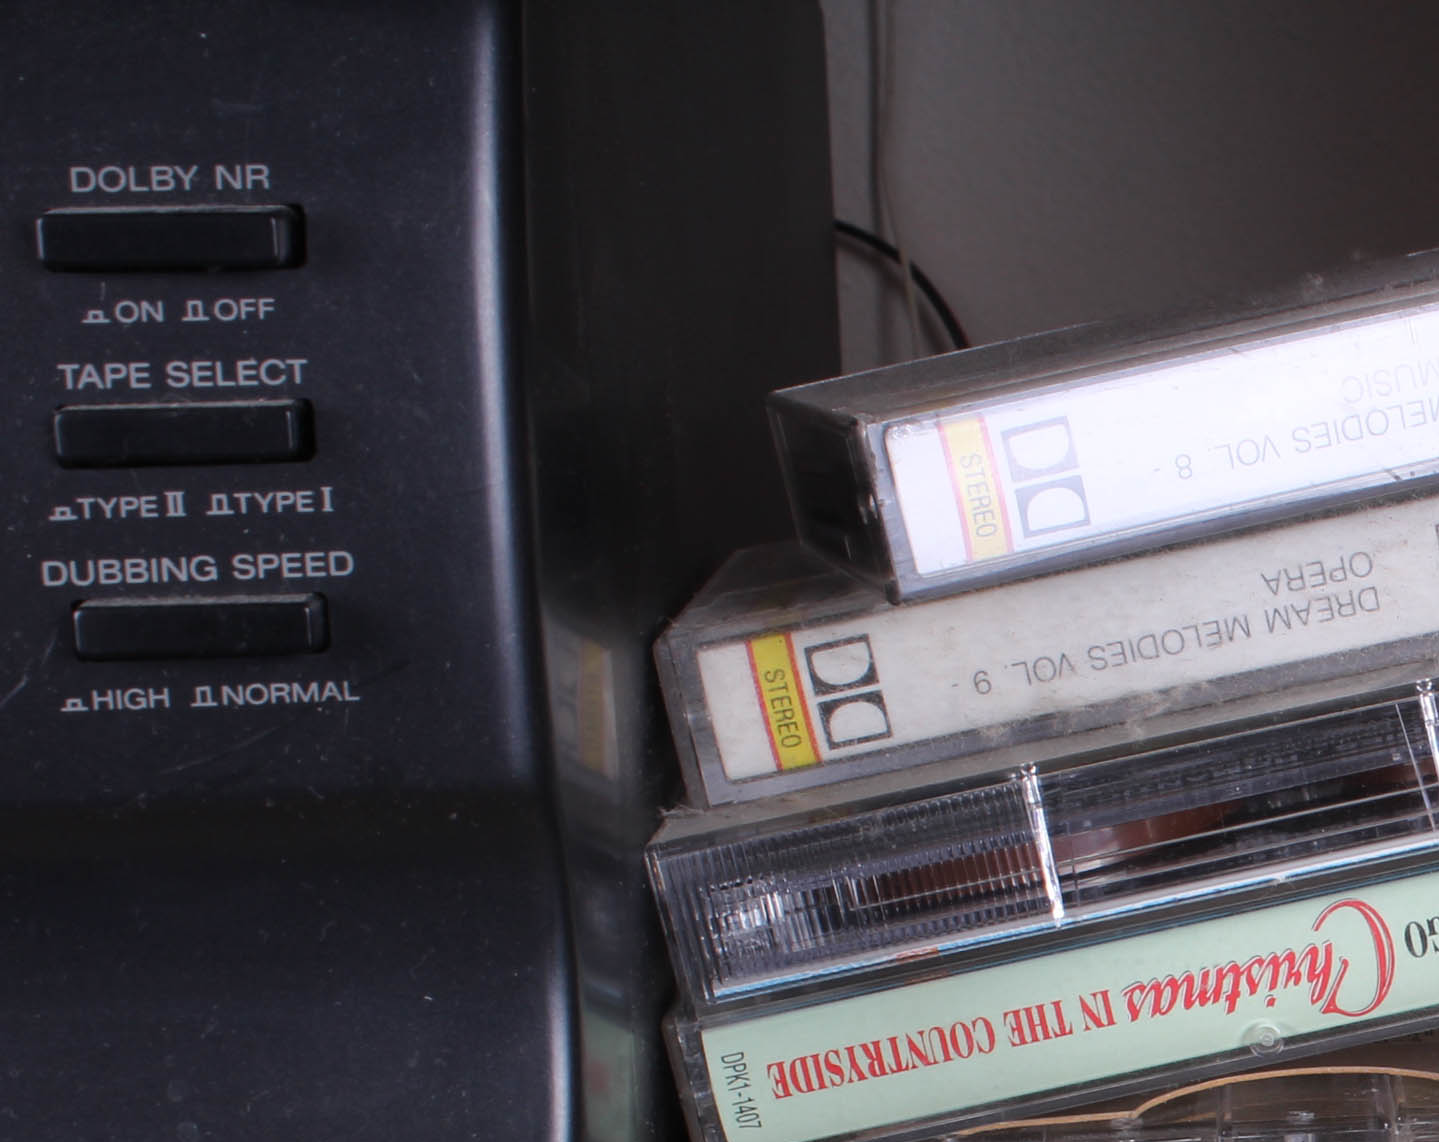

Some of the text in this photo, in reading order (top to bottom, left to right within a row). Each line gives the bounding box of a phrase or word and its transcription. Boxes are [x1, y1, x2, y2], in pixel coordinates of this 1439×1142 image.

[70, 165, 270, 193] DOLBY NR
[116, 300, 164, 324] ON
[214, 299, 275, 321] OFF
[58, 358, 308, 391] TAPE SELECT
[1175, 453, 1193, 480] 8
[77, 497, 159, 520] TYPE
[233, 491, 314, 514] TYPE
[960, 451, 998, 538] STEREO
[42, 551, 354, 588] DUBBING SPEED
[1262, 551, 1373, 596] OPERA
[973, 585, 1380, 695] DREAM MELODIES VOL. 9
[92, 688, 170, 711] HIGH
[222, 681, 360, 706] NORMAL
[764, 668, 802, 750] STEREO
[766, 897, 1395, 1100] Christmas IN THE COUNTRYSIDE
[720, 1051, 763, 1130] DPK1-1407
